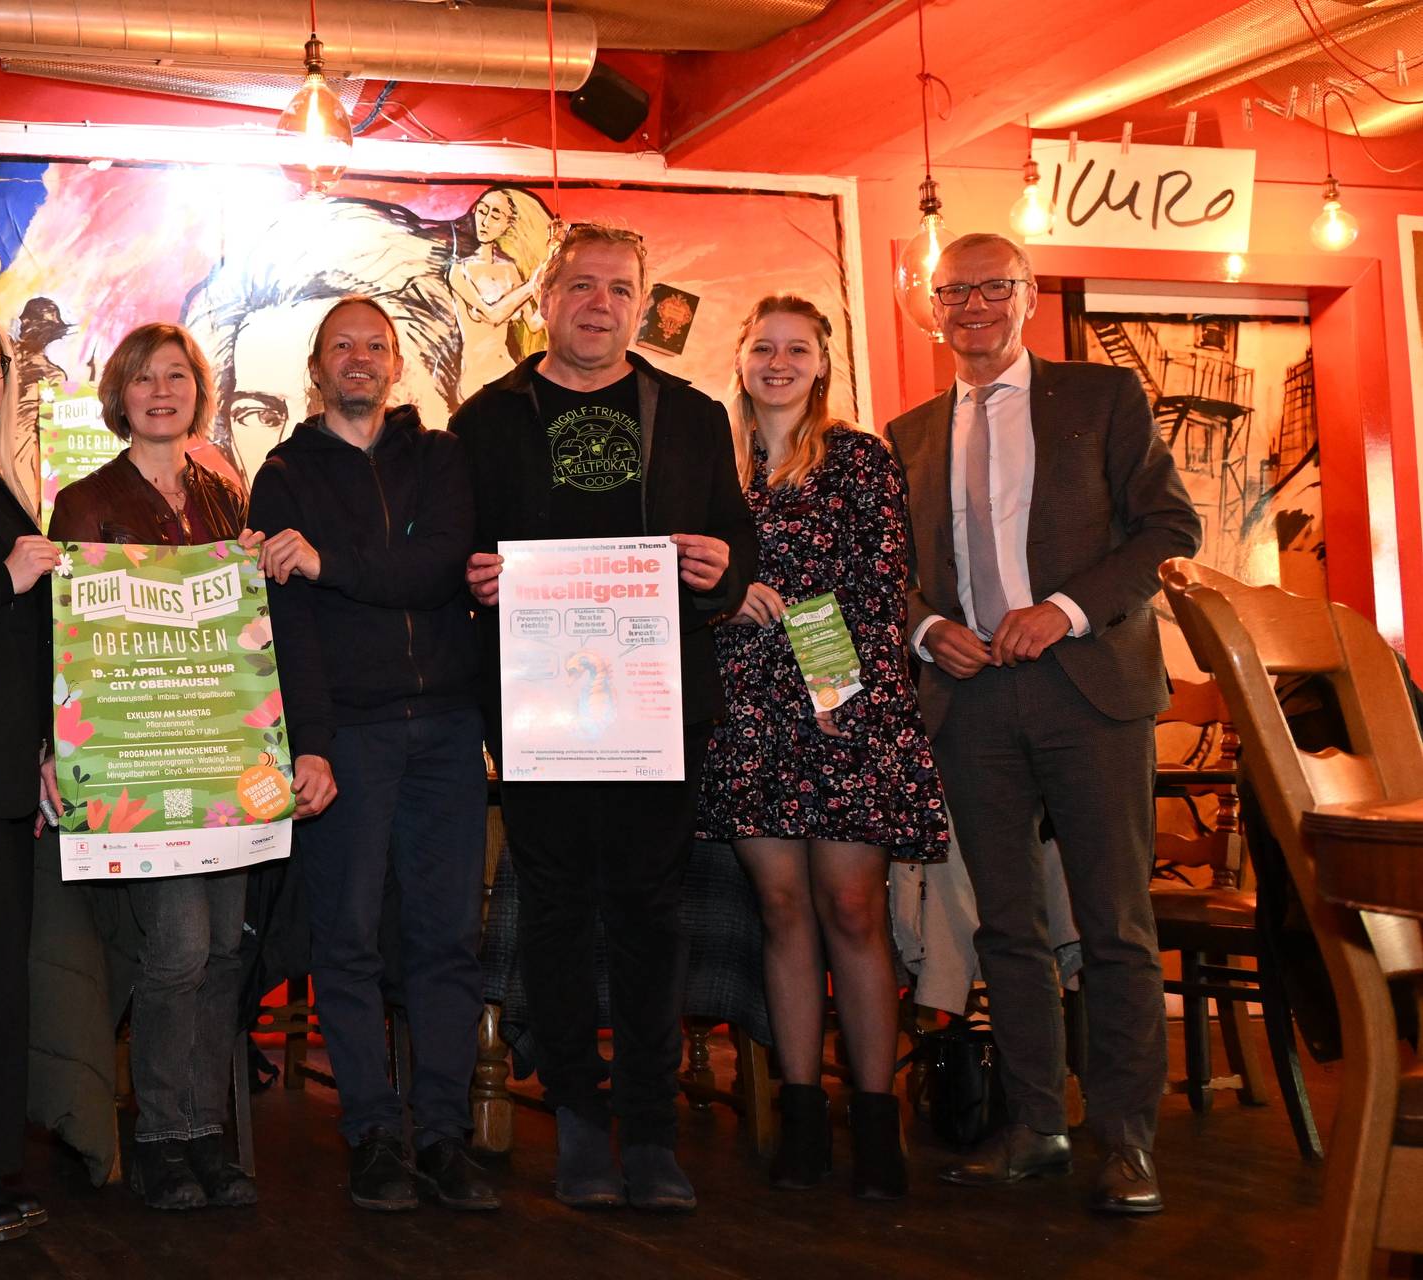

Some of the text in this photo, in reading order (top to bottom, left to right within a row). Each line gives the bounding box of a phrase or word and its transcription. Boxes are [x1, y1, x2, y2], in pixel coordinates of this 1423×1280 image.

[566, 459, 633, 475] WELTPOKAL
[638, 541, 667, 550] Thema
[77, 571, 233, 614] FRÜH LINGS FEST
[92, 628, 229, 657] OBERHAUSEN
[132, 667, 167, 678] APRIL
[176, 665, 193, 675] AB
[195, 665, 207, 674] 12
[209, 663, 235, 674] UHR
[109, 677, 220, 691] CITY OBERHAUSEN
[183, 691, 197, 700] und
[126, 708, 211, 720] EXKLUSIV AM SAMSTAG
[118, 745, 229, 759] PROGRAMM AM WOCHENENDE
[197, 756, 225, 766] Walking
[251, 835, 275, 846] CONTACT
[201, 857, 213, 865] vhs
